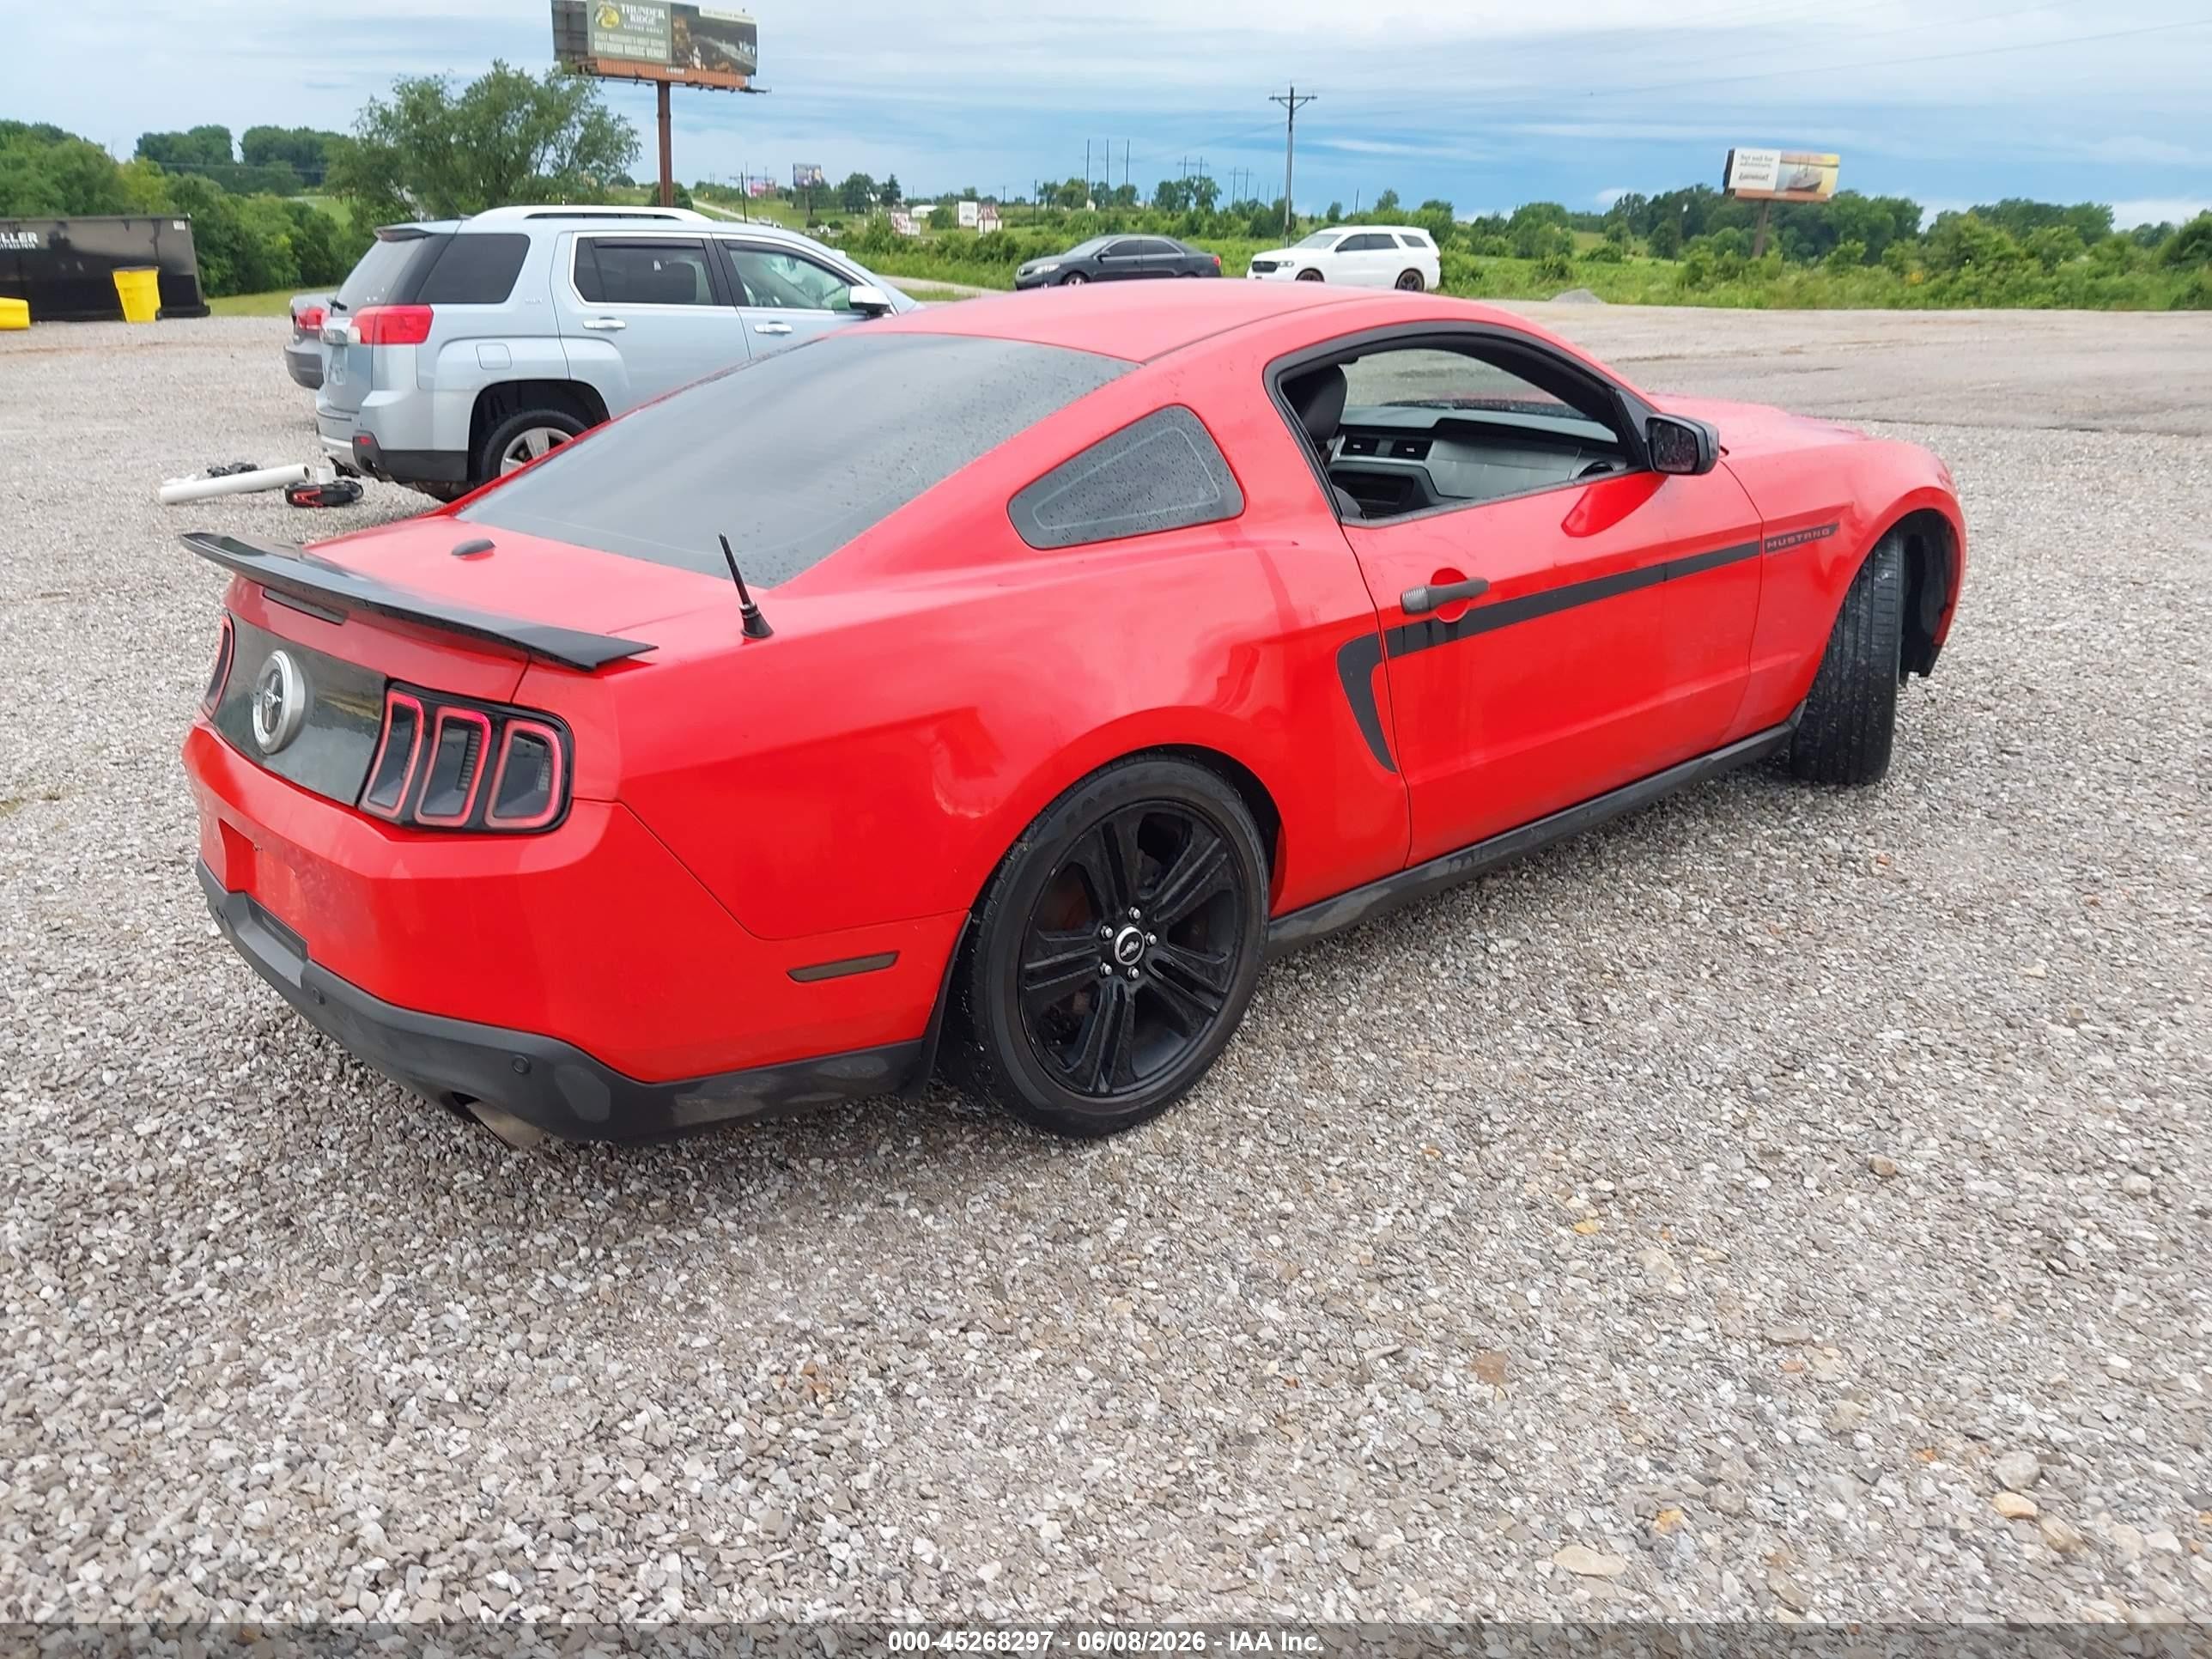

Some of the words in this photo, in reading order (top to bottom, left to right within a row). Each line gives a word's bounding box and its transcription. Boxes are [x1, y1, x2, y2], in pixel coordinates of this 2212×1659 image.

[621, 3, 665, 20] THUNDER
[0, 231, 39, 245] LLER
[1766, 527, 1831, 550] MUSTANG
